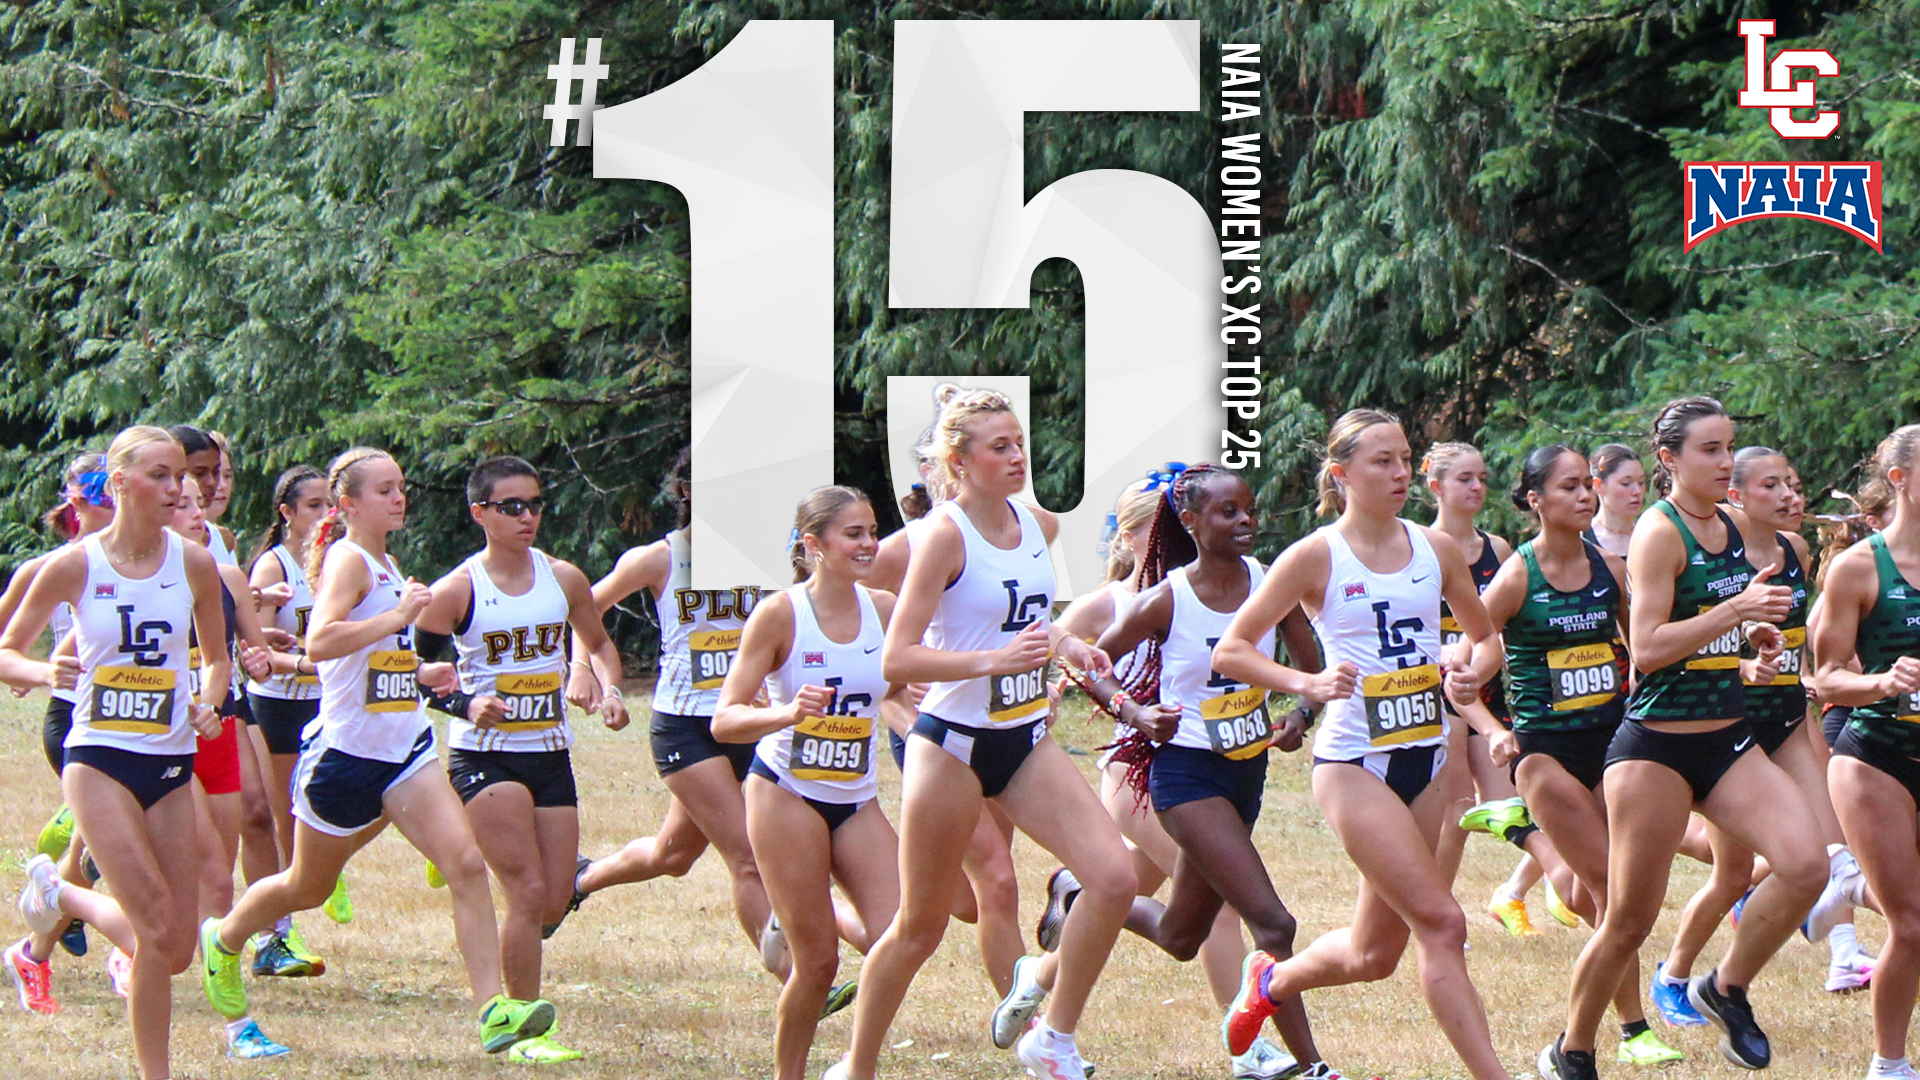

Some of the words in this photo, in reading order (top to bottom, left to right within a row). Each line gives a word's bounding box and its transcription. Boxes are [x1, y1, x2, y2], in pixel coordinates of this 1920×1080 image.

[1706, 572, 1749, 592] PORTLAND
[1717, 583, 1743, 598] STATE
[674, 586, 761, 625] PLU
[1548, 610, 1608, 627] PORTLAND
[115, 604, 173, 666] LC
[703, 633, 742, 647] Athlet
[1371, 600, 1425, 669] LC
[1563, 620, 1598, 633] STATE
[482, 621, 564, 665] PLU
[700, 650, 738, 678] 90
[1563, 650, 1606, 665] Athletic
[1779, 648, 1800, 673] 95
[109, 671, 163, 686] Athletic
[511, 678, 553, 690] Athletic
[1000, 666, 1044, 706] 9061
[1380, 673, 1429, 692] Athletic
[1560, 664, 1615, 697] 9099
[101, 689, 166, 720] 9057
[503, 693, 555, 721] 9071
[1377, 691, 1437, 731] 9056
[811, 720, 862, 735] Athletic
[1217, 708, 1267, 750] 9058
[801, 738, 862, 769] 9059
